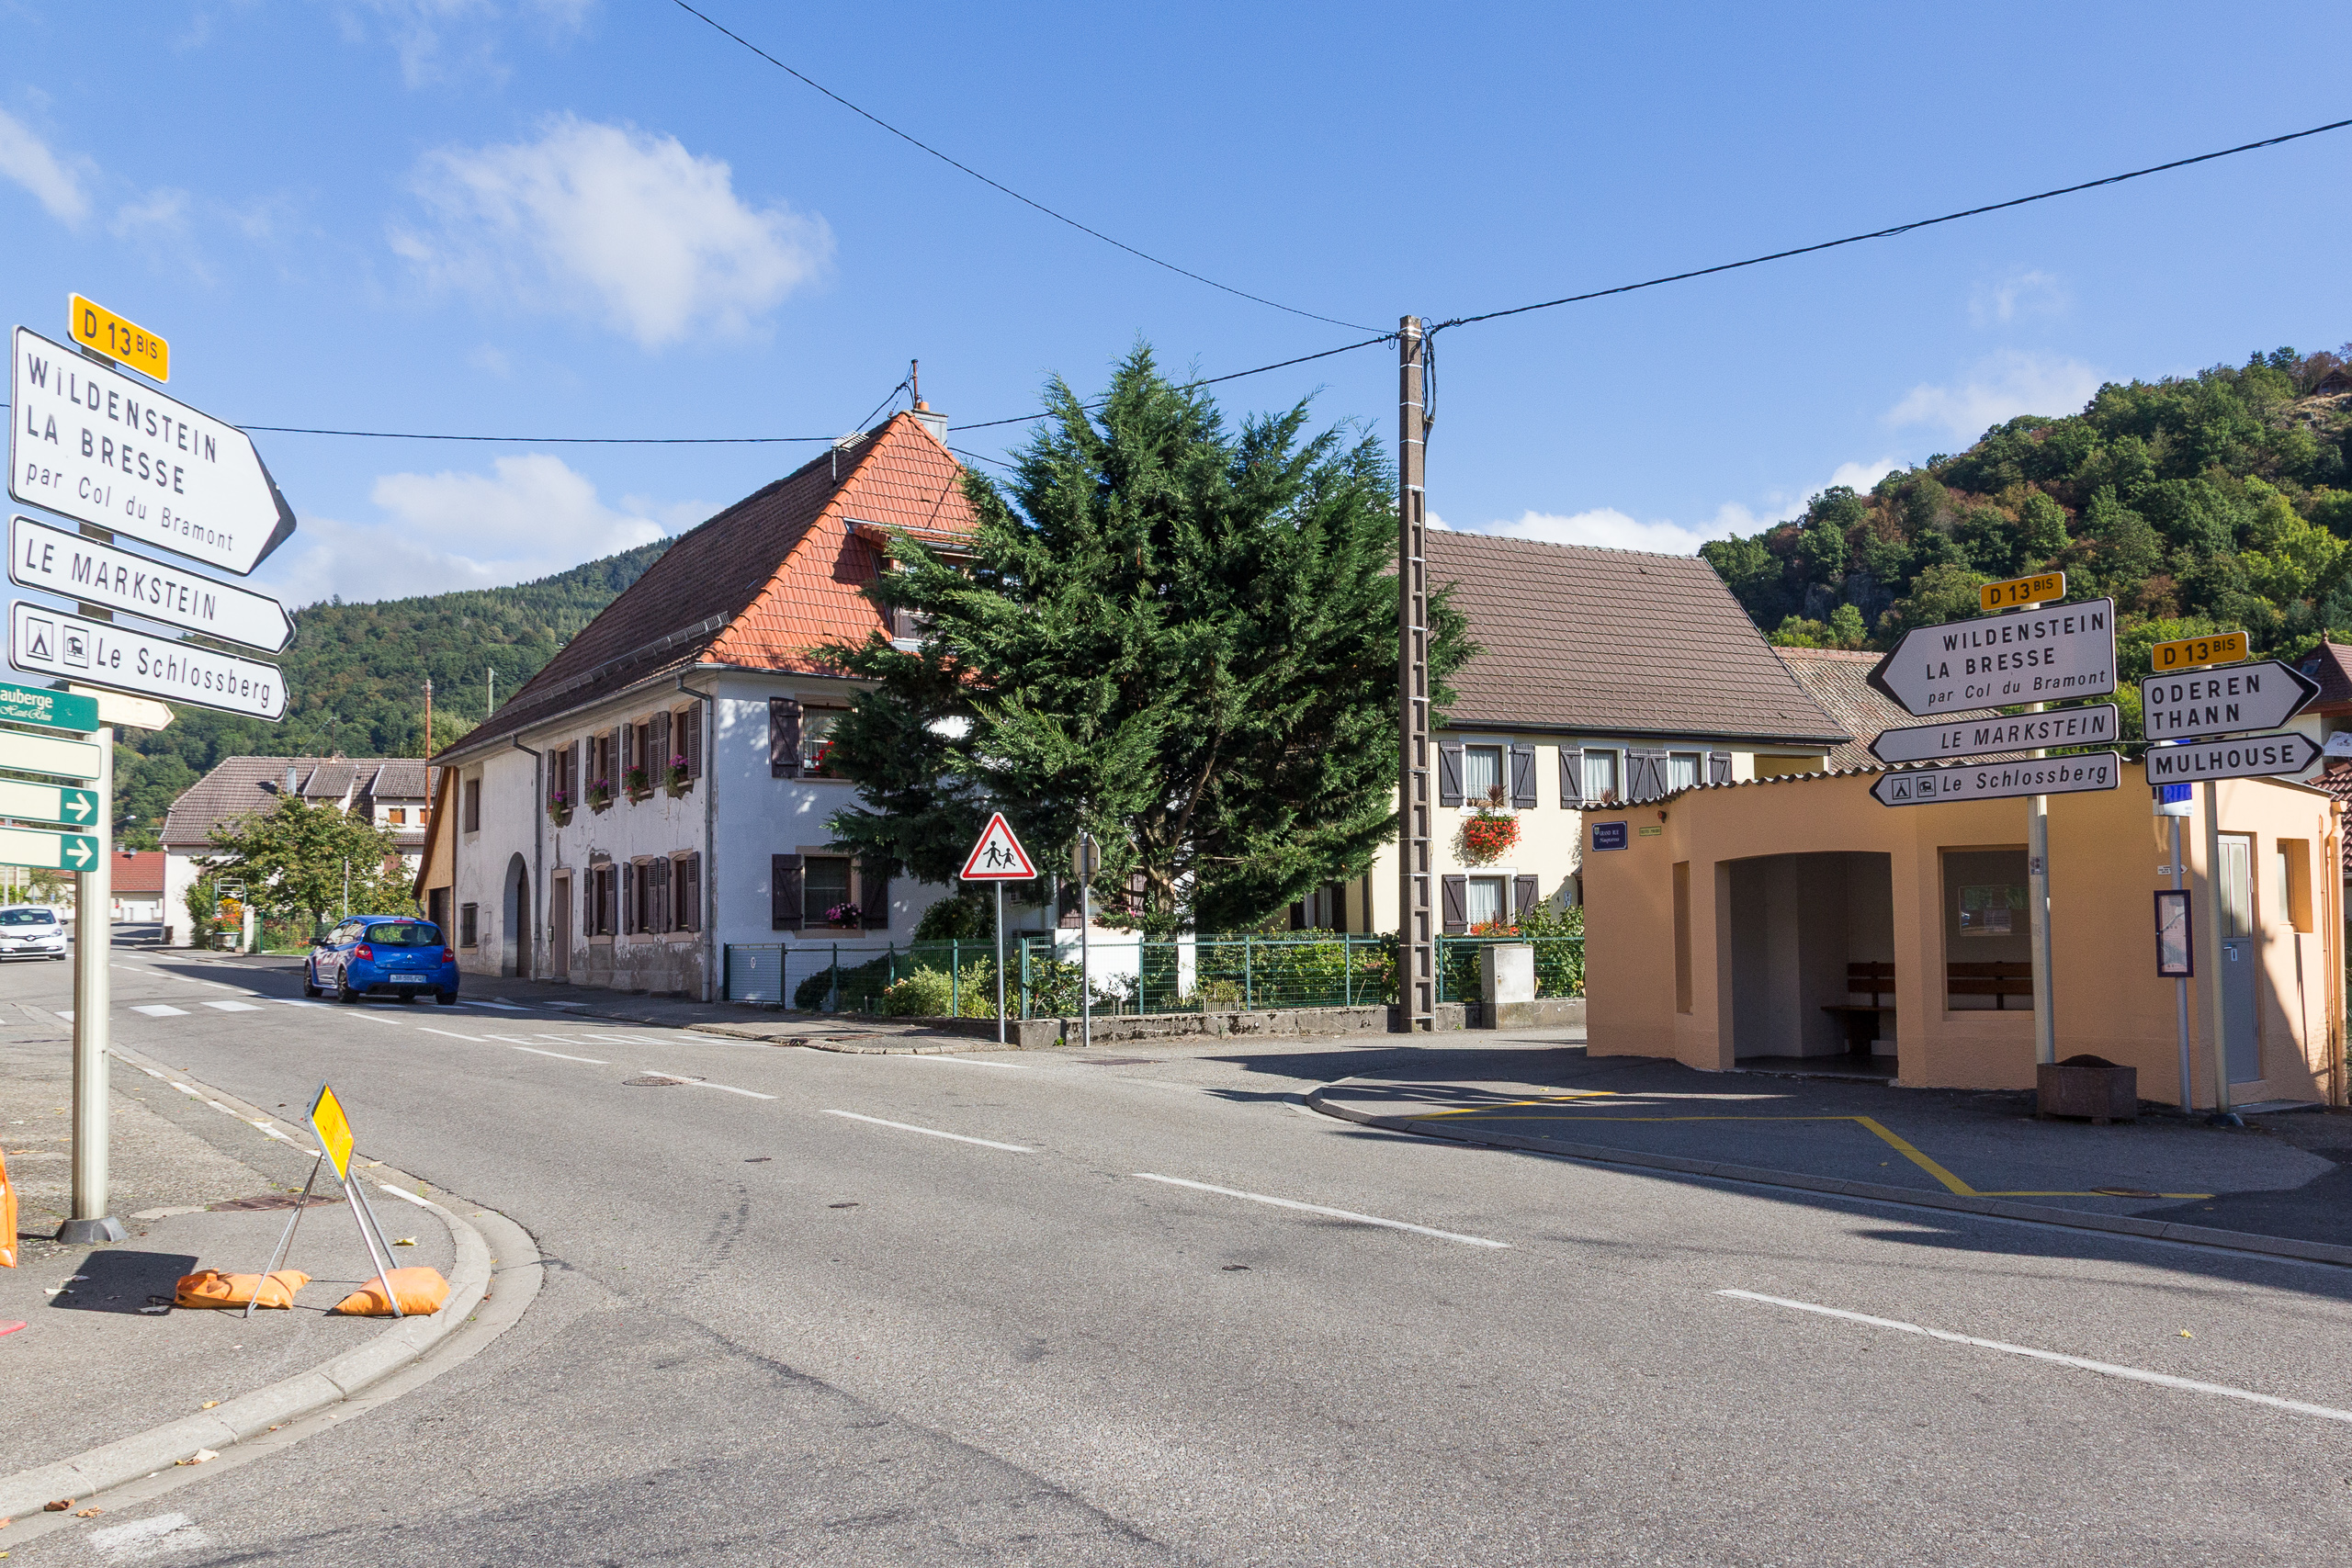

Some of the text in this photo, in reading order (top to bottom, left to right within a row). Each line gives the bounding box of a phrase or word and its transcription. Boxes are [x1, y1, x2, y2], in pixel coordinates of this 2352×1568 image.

[85, 308, 96, 338] D
[28, 353, 216, 463] WILDENSTEIN
[28, 405, 184, 494] LA BRESSE
[27, 463, 233, 551] par Col du Bramont
[27, 538, 216, 621] LE MARKSTEIN
[1990, 588, 2001, 605] D
[1943, 612, 2104, 651] WILDENSTEIN
[97, 637, 120, 669] Le
[138, 648, 270, 708] Schlossberg
[1927, 648, 2054, 680] LA BRESSE
[2164, 648, 2176, 665] D
[0, 688, 53, 710] auberge
[1928, 670, 2106, 706] par Col du Bramont
[2152, 674, 2260, 705] ODEREN
[1941, 715, 2105, 750] LE MARKSTEIN
[2153, 704, 2239, 730] THANN
[2155, 744, 2294, 775] MULHOUSE
[1943, 764, 2108, 793] Le Schlossberg
